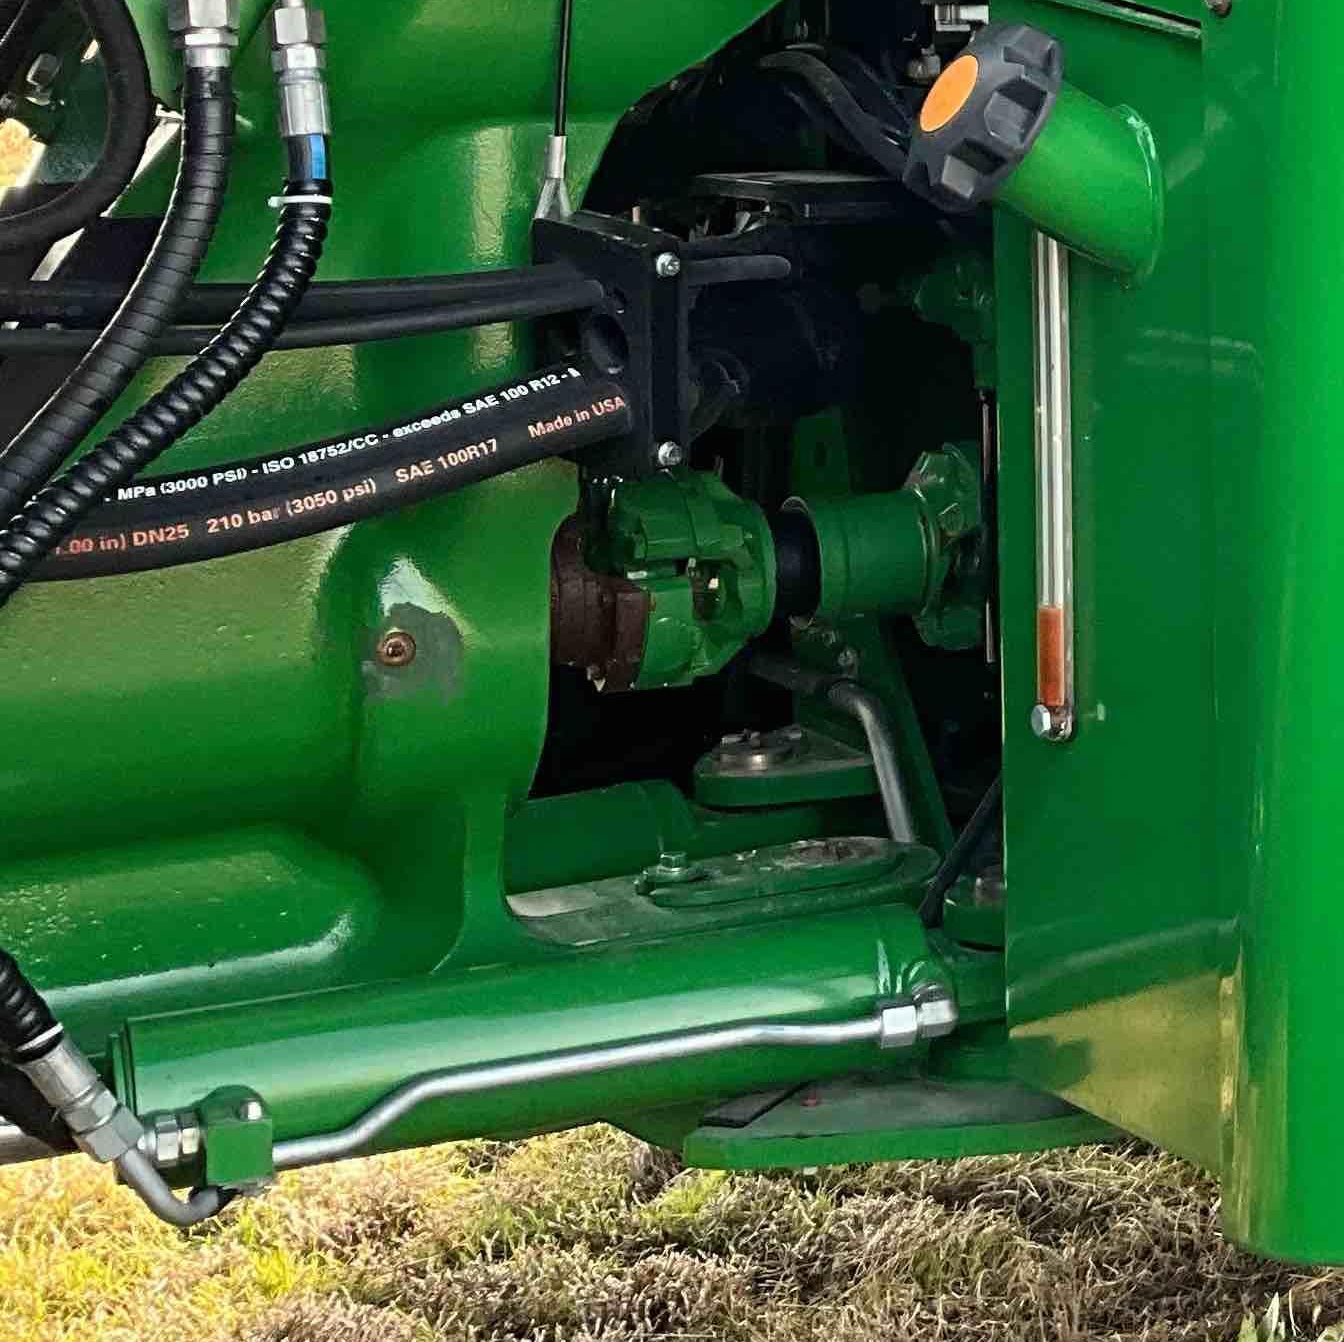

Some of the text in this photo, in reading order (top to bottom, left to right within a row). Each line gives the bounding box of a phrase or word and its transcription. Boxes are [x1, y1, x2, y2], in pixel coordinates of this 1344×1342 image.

[117, 485, 156, 502] MPa
[159, 475, 208, 495] (3000
[213, 466, 248, 485] PSI)
[262, 457, 296, 475] ISO
[299, 432, 379, 465] 18752/CC
[391, 409, 462, 438] exceeds
[462, 393, 499, 415] SAE
[500, 384, 529, 401] 100
[528, 373, 561, 393] R12
[132, 523, 191, 547] DN25
[206, 512, 243, 534] 210
[247, 505, 280, 525] bar
[286, 488, 338, 517] (3050
[342, 477, 378, 502] psi)
[394, 459, 435, 484] SAE
[437, 437, 499, 470] 100R17
[527, 414, 573, 439] Made
[574, 408, 591, 423] in
[591, 395, 627, 417] USA
